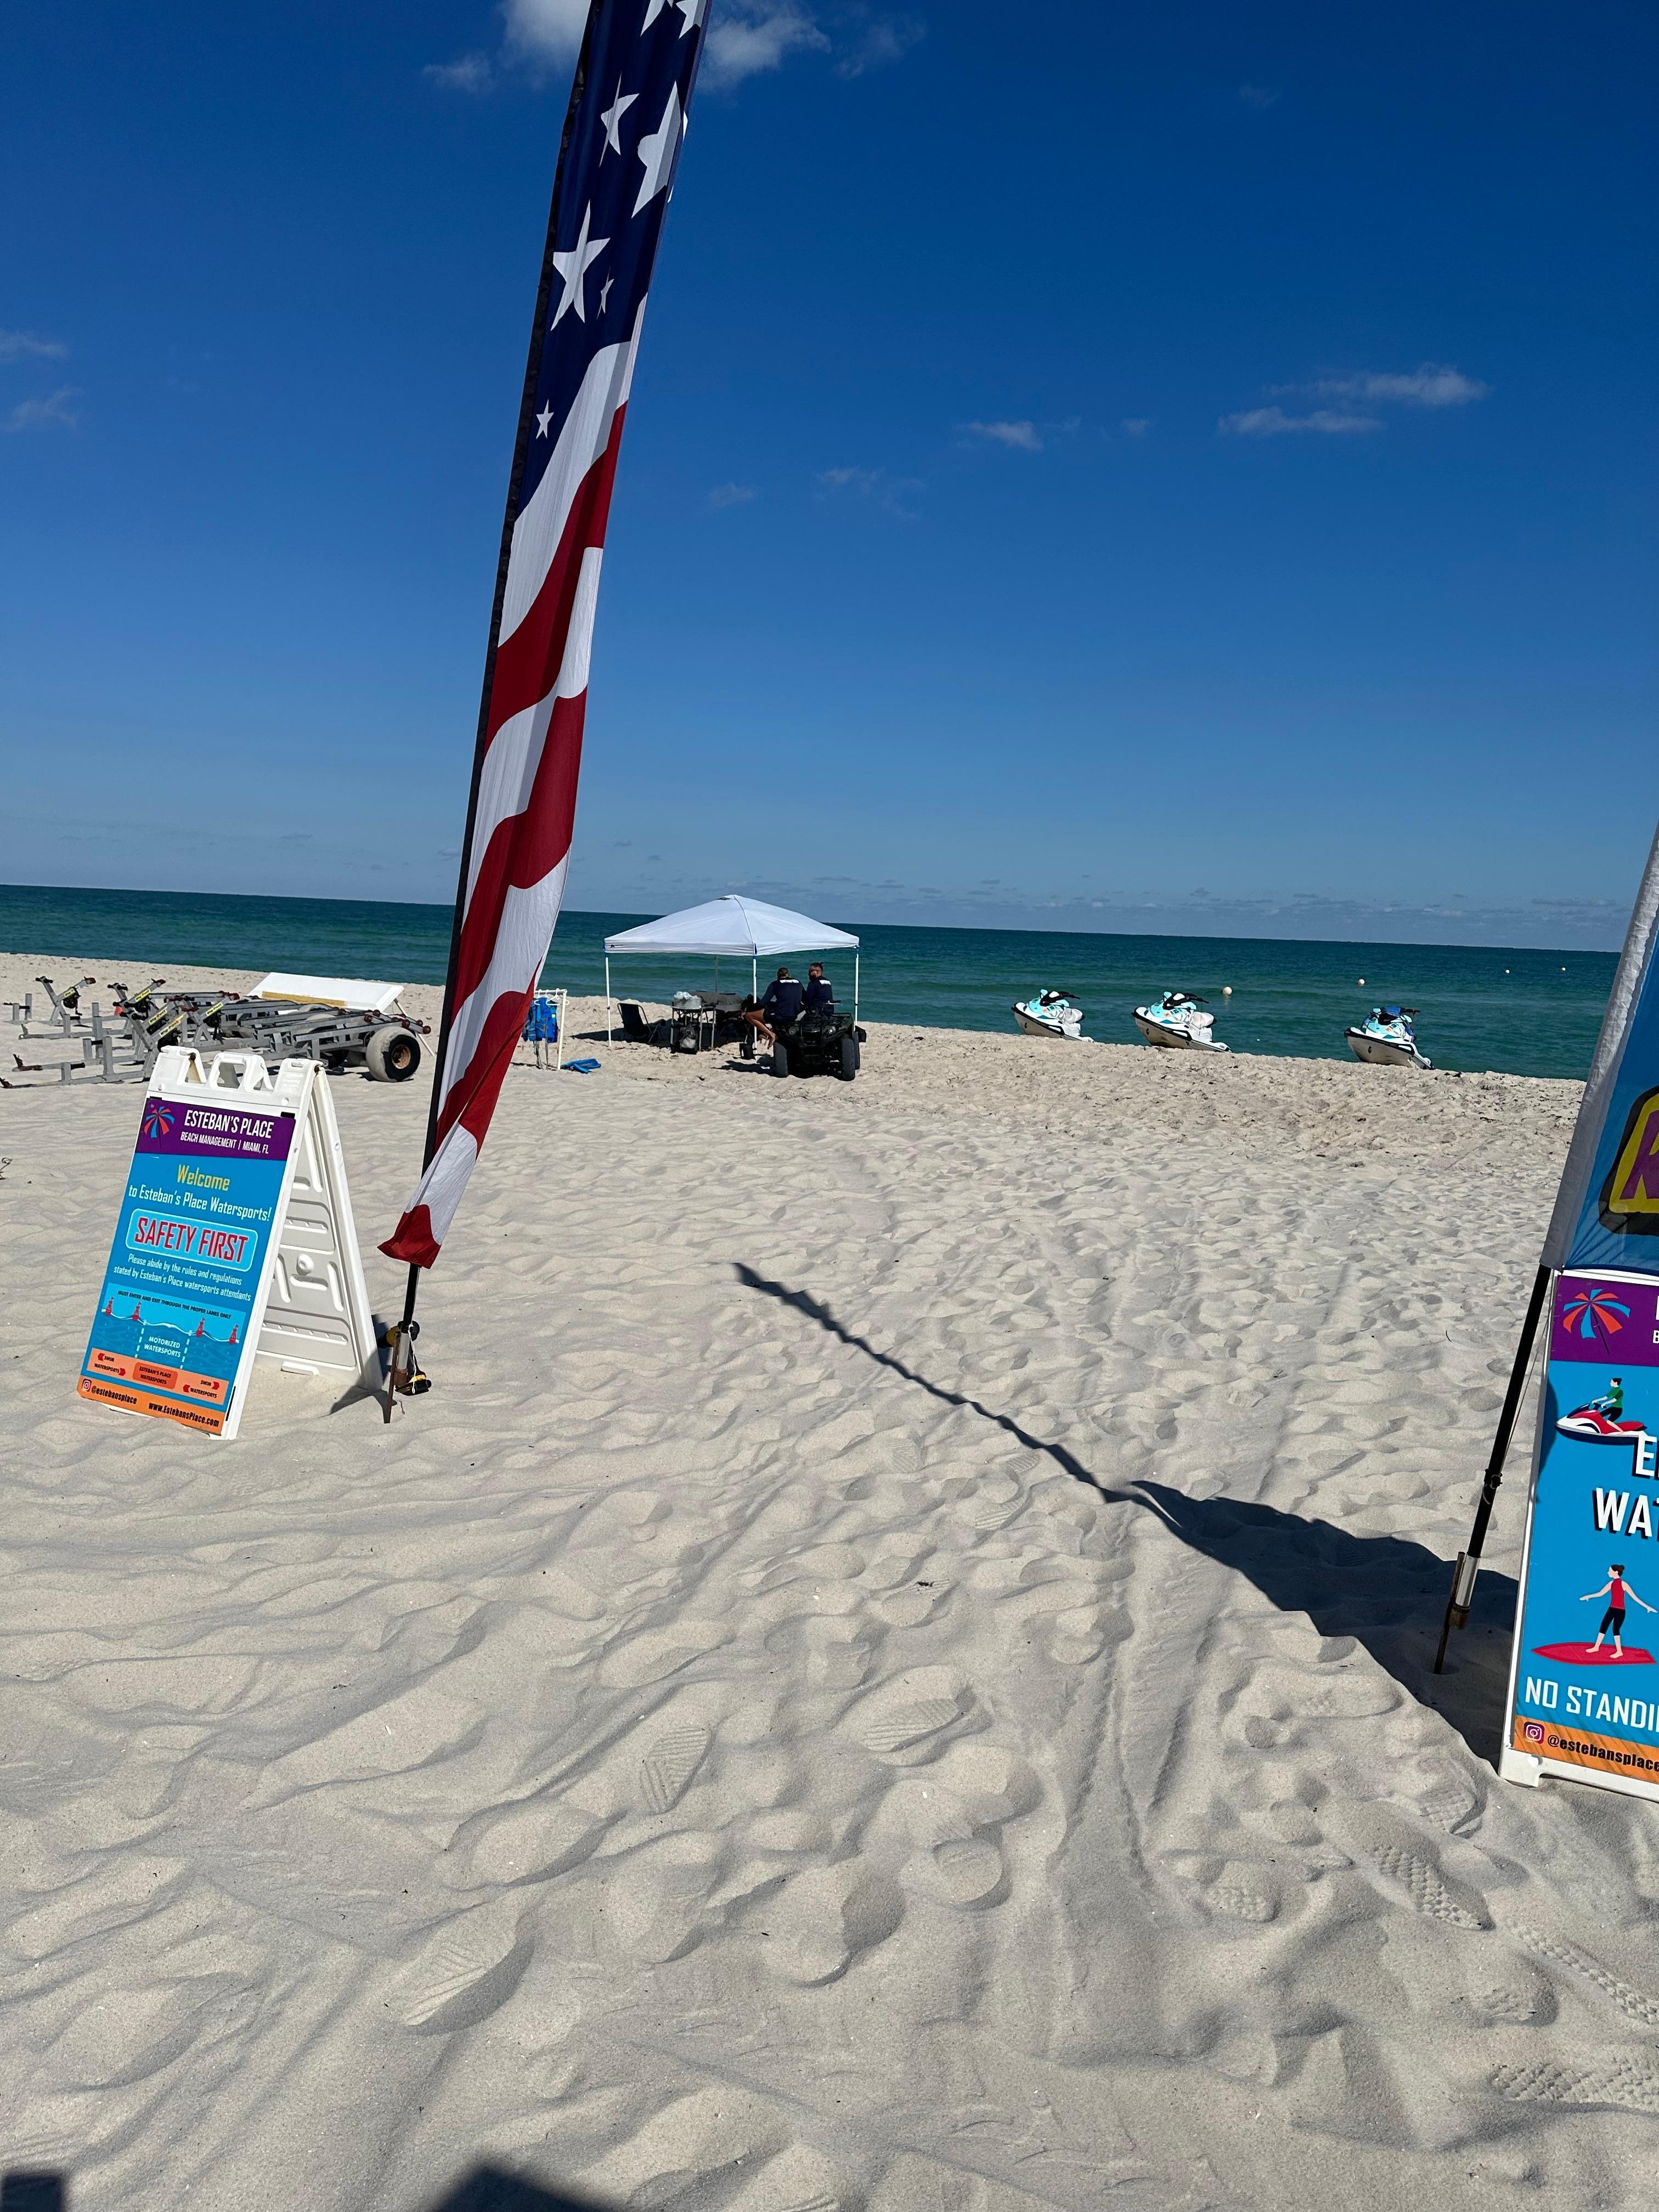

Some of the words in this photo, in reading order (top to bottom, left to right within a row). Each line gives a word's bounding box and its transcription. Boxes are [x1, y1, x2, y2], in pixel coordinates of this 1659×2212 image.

[184, 1109, 240, 1133] ESTEBAN'S
[240, 1118, 275, 1139] PLACE
[180, 1131, 199, 1143] BEACH
[199, 1134, 237, 1149] MANAGEMENT
[242, 1141, 261, 1154] MIAMI,
[262, 1144, 269, 1154] FL
[177, 1164, 231, 1192] Welcome
[128, 1184, 138, 1198] to
[139, 1184, 181, 1205] Esteban's
[183, 1192, 208, 1210] Place
[210, 1196, 272, 1222] Watersports!
[134, 1217, 198, 1252] SAFETY
[198, 1229, 249, 1262] FIRST
[128, 1253, 146, 1266] Please
[147, 1258, 162, 1269] abide
[163, 1261, 170, 1272] by
[171, 1262, 181, 1274] the
[182, 1266, 197, 1277] rules
[198, 1268, 208, 1278] and
[210, 1272, 242, 1286] regulations
[113, 1266, 131, 1276] stated
[132, 1267, 139, 1278] by
[139, 1270, 167, 1284] Esteban's
[167, 1275, 183, 1287] Place
[184, 1281, 219, 1295] watersports
[220, 1286, 251, 1302] attendants
[161, 1299, 182, 1308] THROUGH
[190, 1306, 206, 1314] PROPER
[144, 1343, 181, 1358] WATERSPORTS
[148, 1336, 180, 1348] MOTORIZED
[94, 1363, 120, 1373] WATERSPORTS
[139, 1366, 160, 1375] ESTEBAN'S
[140, 1374, 167, 1385] WATERSPORTS
[91, 1385, 137, 1404] @estebansplace
[190, 1387, 217, 1398] WATERSPORTS
[148, 1402, 219, 1427] www.EstebansPlace.com
[1596, 1487, 1659, 1537] WA
[1525, 1676, 1559, 1709] NO
[1566, 1685, 1659, 1733] STANDI
[1547, 1734, 1659, 1772] @estebansplace
